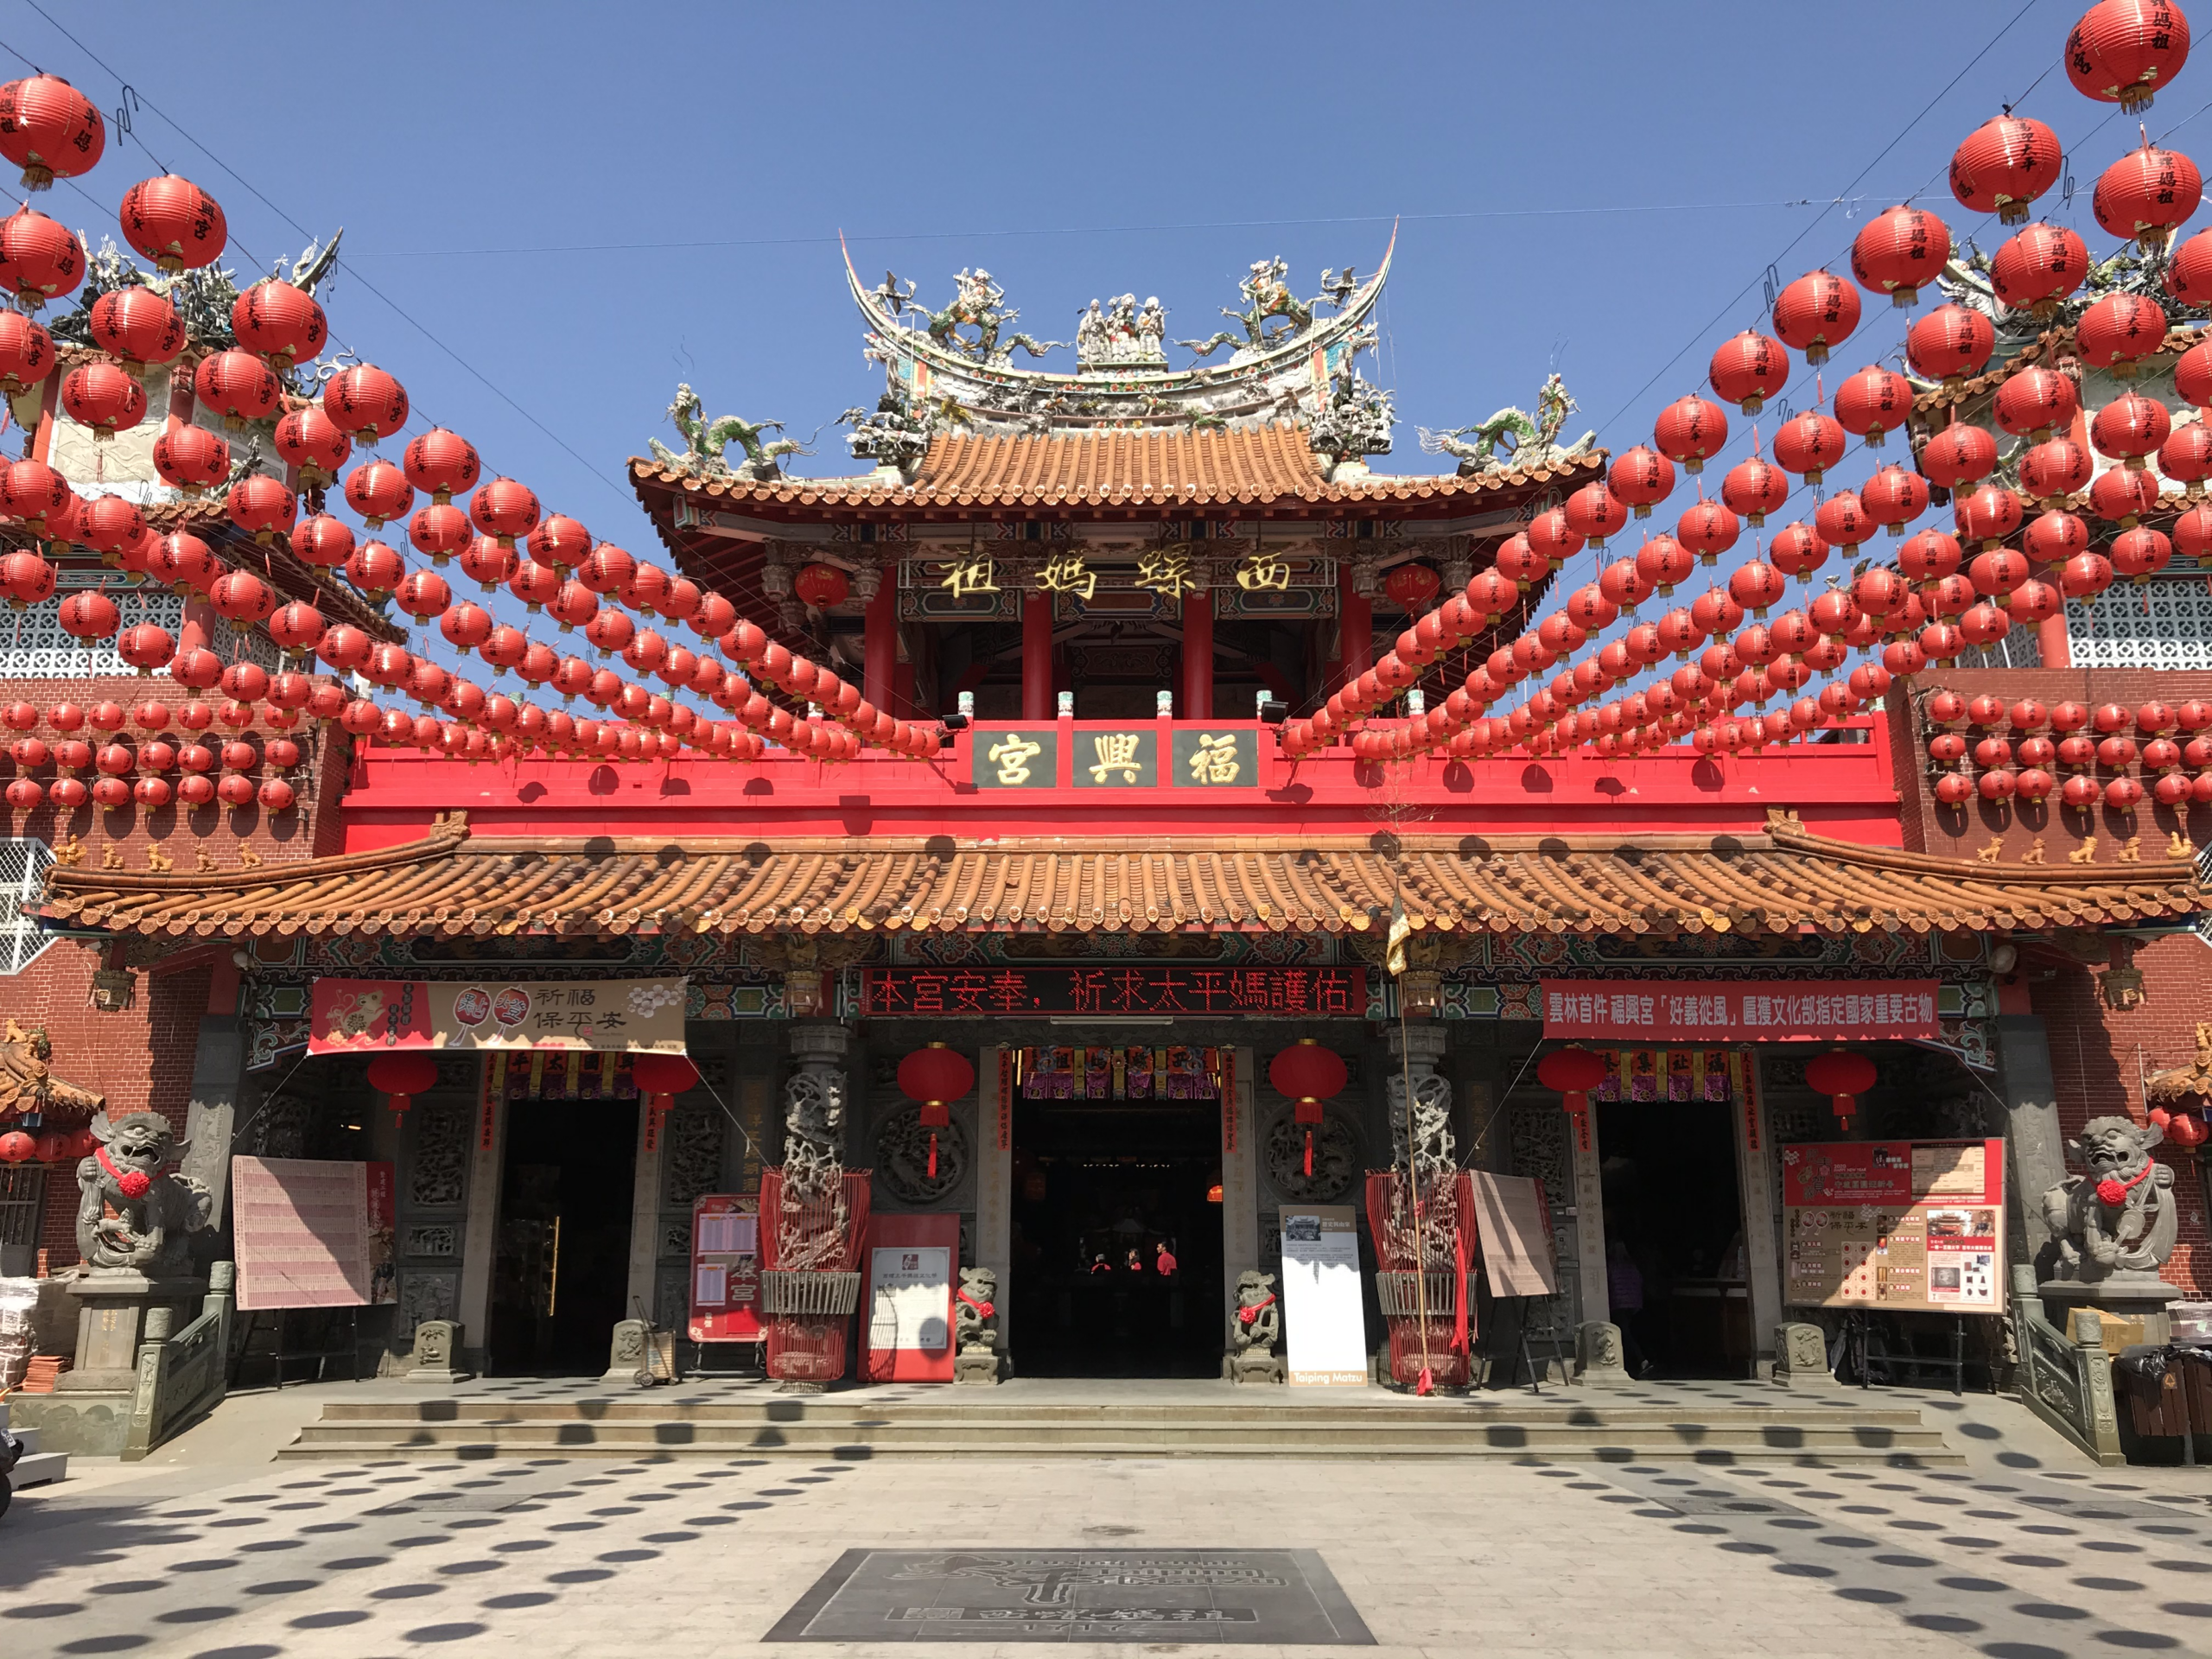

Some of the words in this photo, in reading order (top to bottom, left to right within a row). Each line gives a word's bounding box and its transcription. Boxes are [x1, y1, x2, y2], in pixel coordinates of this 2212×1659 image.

[988, 734, 1241, 785] 福興宮
[534, 988, 596, 1006] 祈福
[533, 1011, 627, 1035] 保平安
[1294, 1372, 1330, 1384] Taiping
[1332, 1372, 1363, 1383] Matzu
